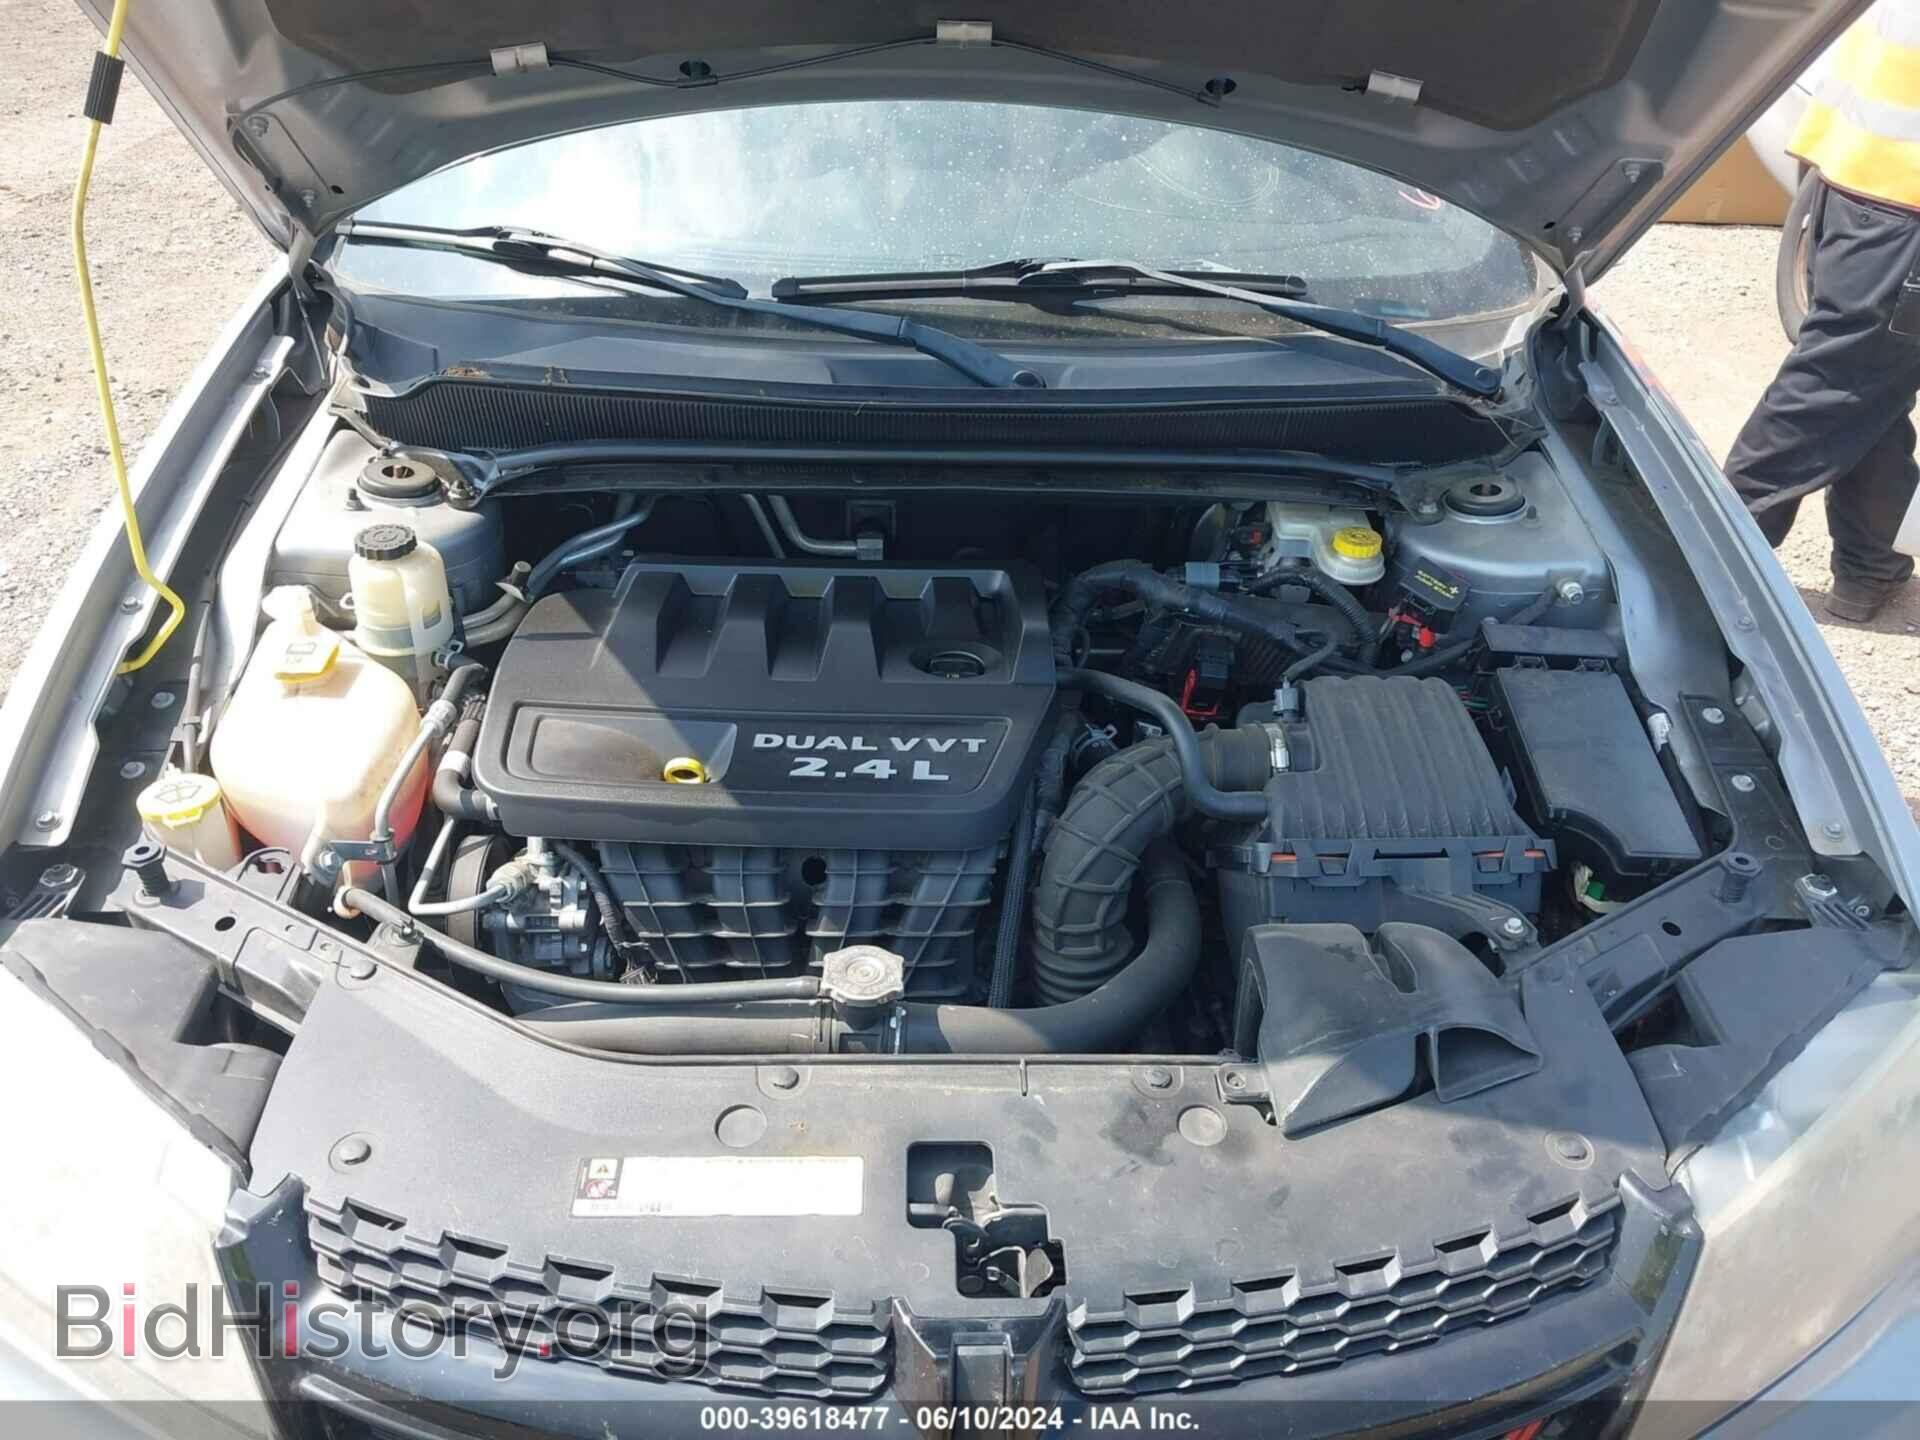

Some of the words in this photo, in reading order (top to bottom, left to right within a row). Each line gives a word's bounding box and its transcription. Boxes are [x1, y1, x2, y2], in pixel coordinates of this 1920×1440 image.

[753, 734, 878, 751] DUAL
[890, 737, 987, 753] VVT
[789, 757, 898, 779] 2.4
[912, 760, 950, 781] L
